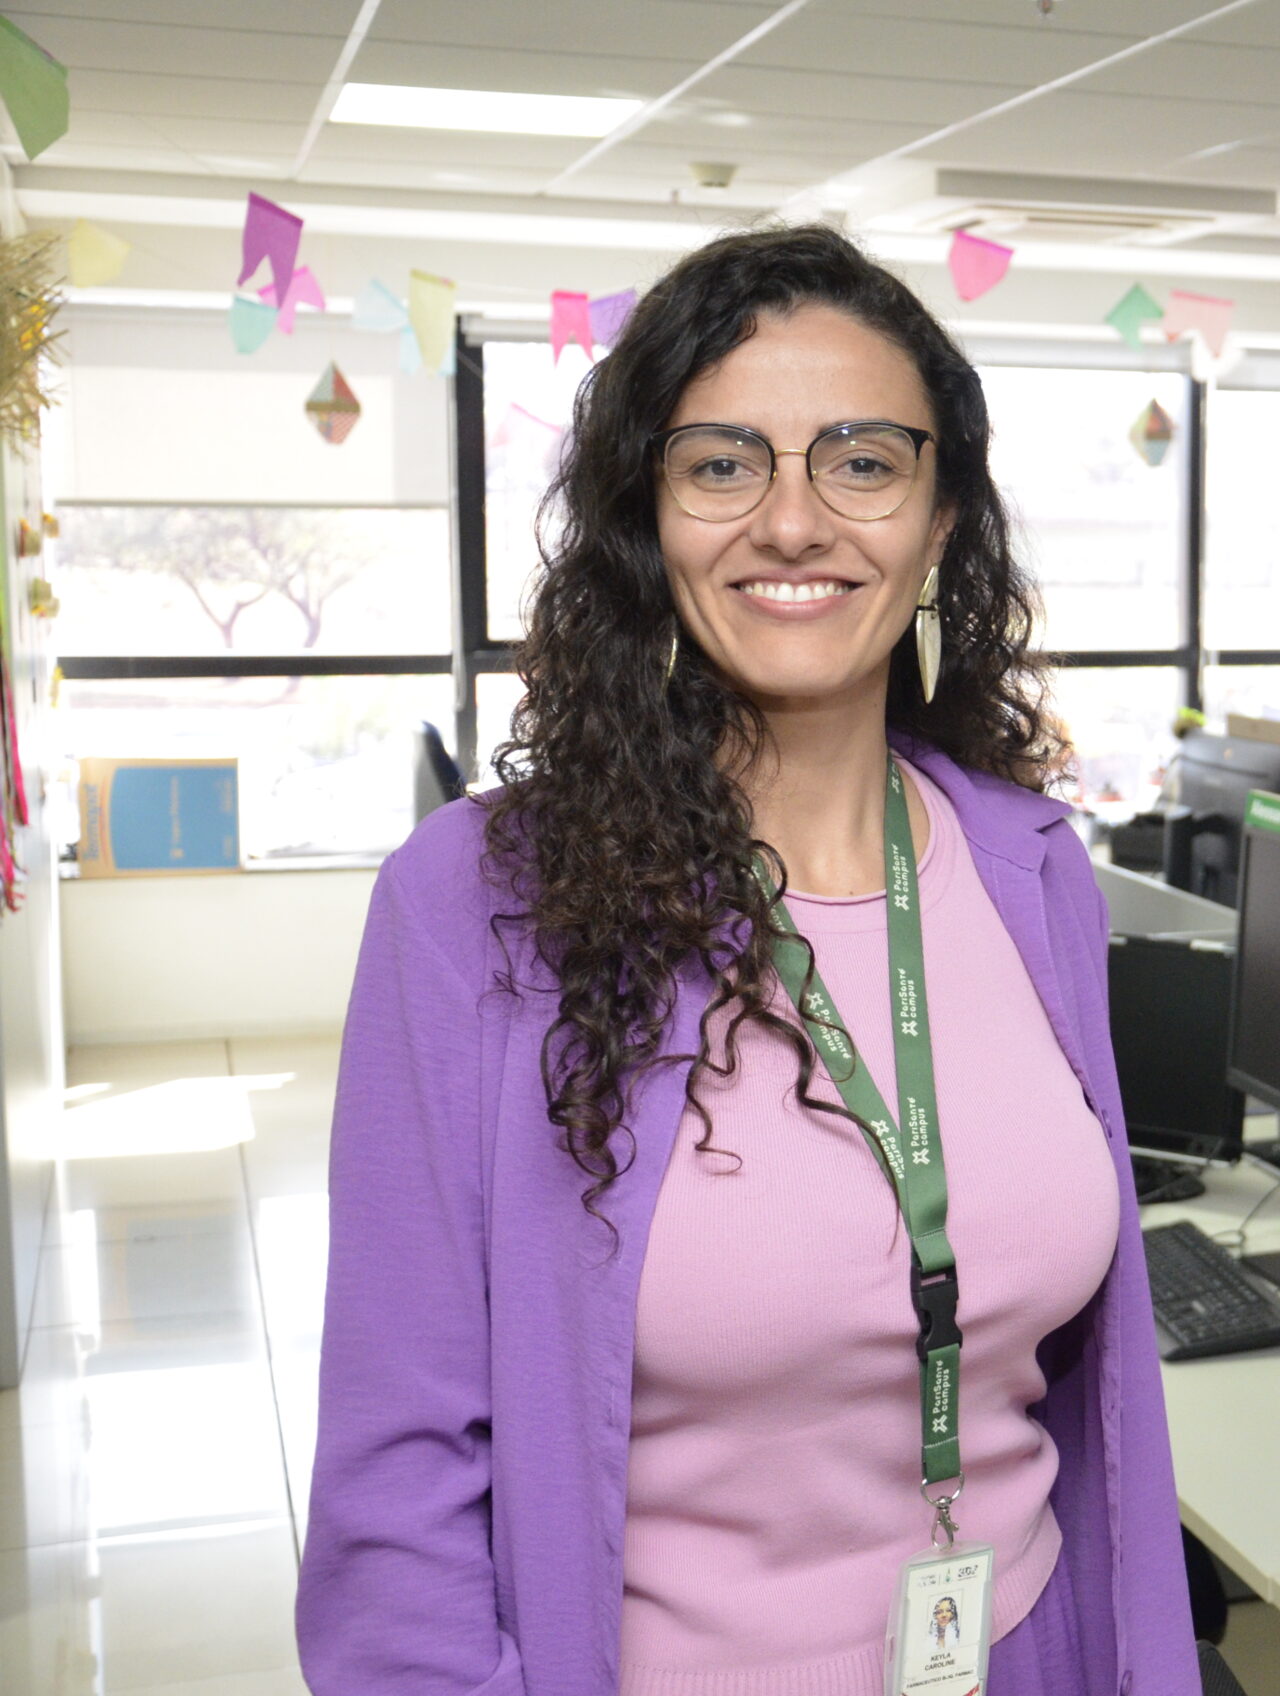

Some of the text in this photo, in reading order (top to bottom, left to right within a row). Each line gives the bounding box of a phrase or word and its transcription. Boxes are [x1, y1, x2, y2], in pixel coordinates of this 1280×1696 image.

[900, 856, 910, 893] campus
[907, 979, 918, 1019] campus
[814, 1012, 838, 1052] cmpus
[820, 1009, 852, 1059] PaSanté
[917, 1108, 929, 1146] campus
[880, 1139, 905, 1179] campus
[941, 1368, 951, 1412] campus
